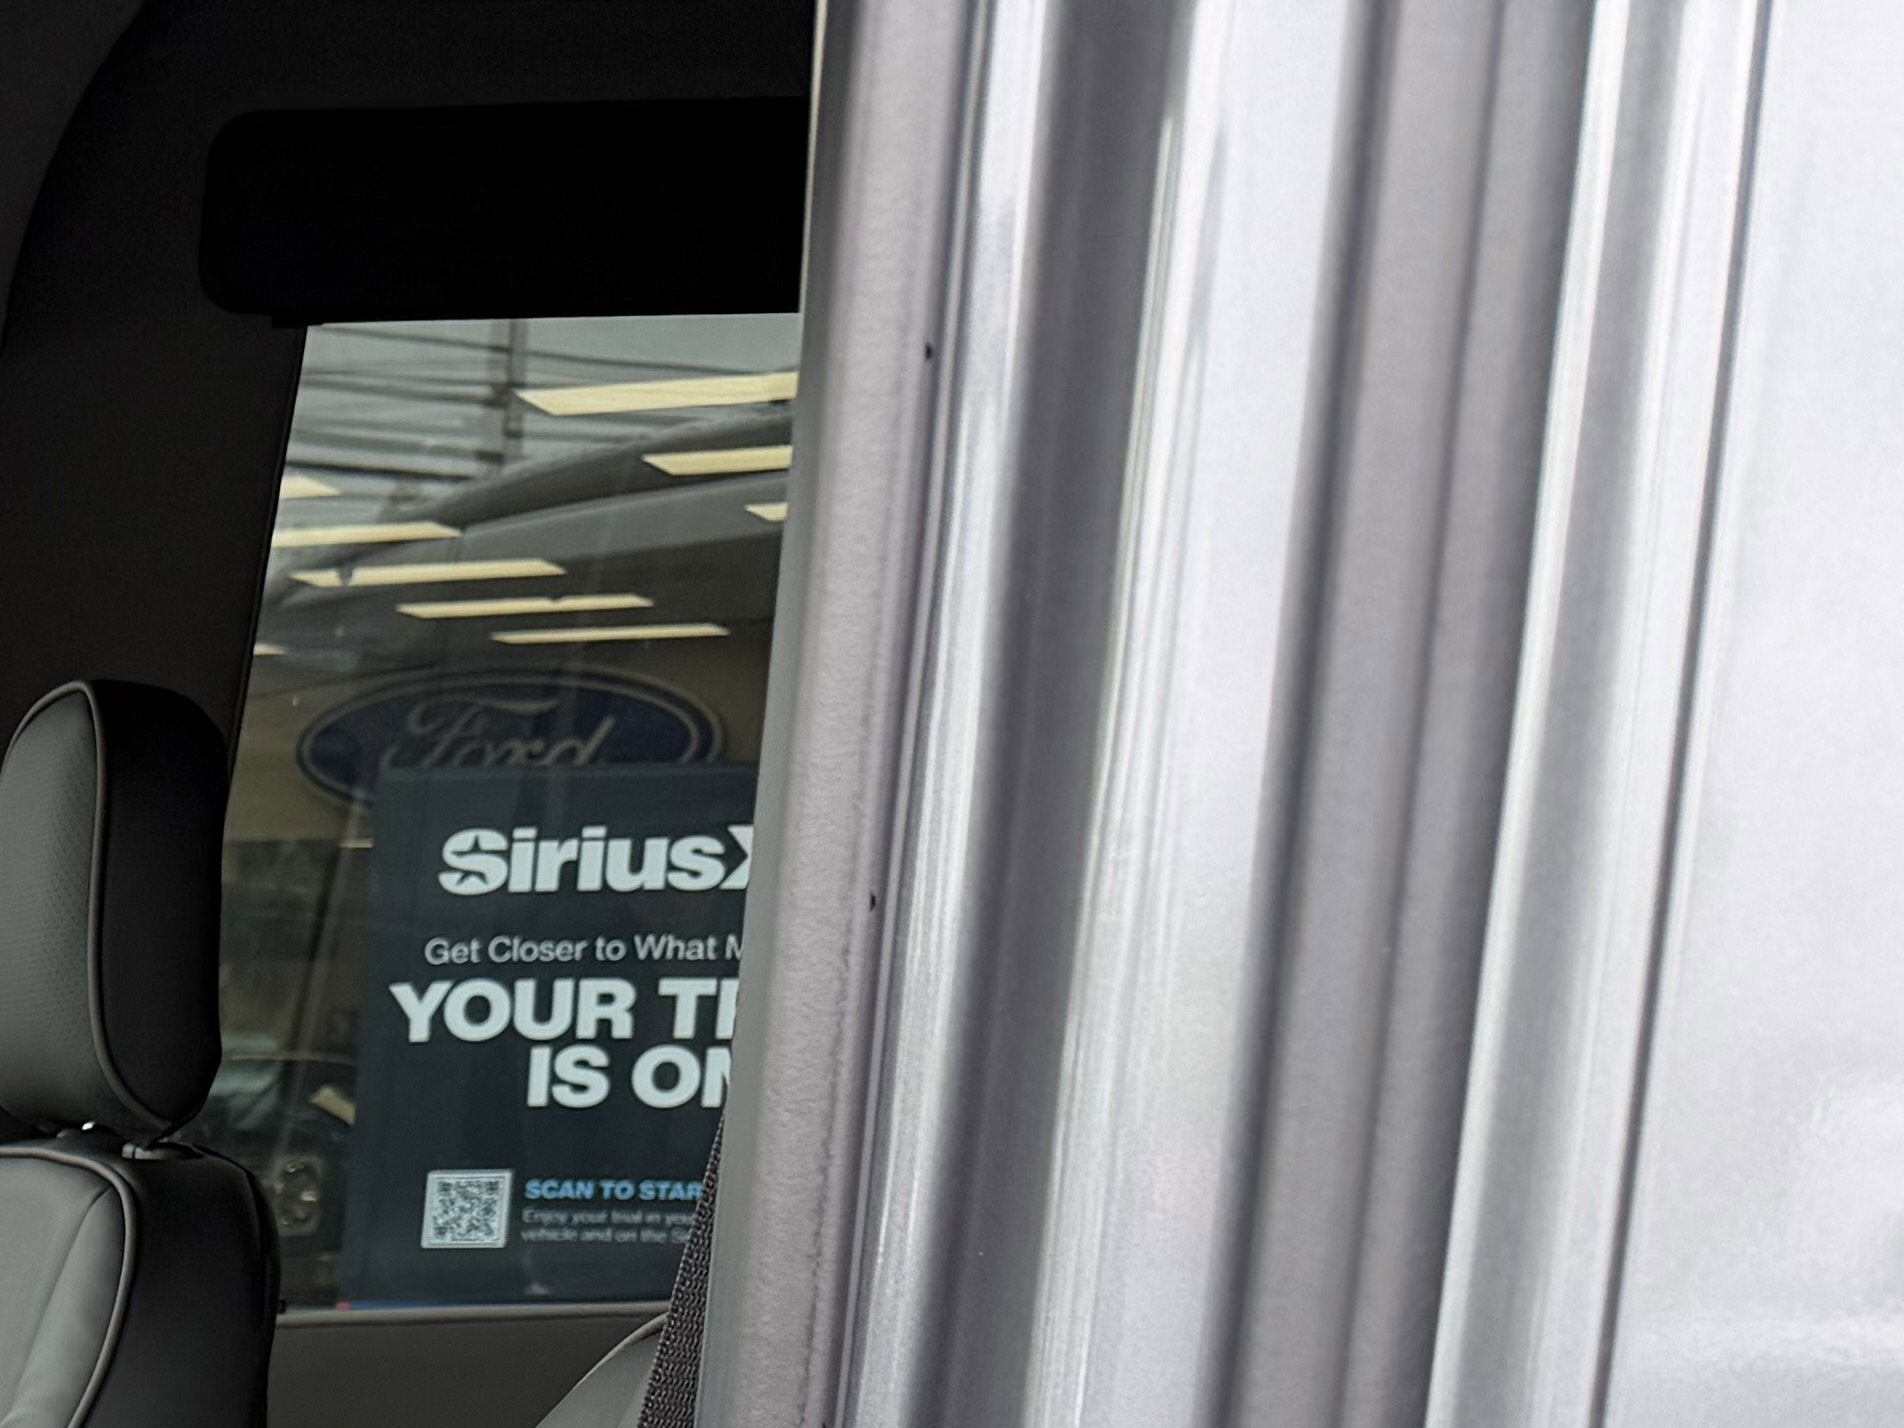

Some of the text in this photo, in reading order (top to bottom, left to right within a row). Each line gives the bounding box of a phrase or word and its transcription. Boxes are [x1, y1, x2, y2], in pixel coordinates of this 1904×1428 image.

[424, 937, 482, 964] Get
[488, 936, 588, 964] Closer
[596, 934, 626, 961] to
[634, 935, 717, 961] What
[389, 978, 637, 1043] YOUR
[526, 1046, 610, 1108] IS
[525, 1179, 595, 1200] SCAN
[599, 1180, 635, 1200] TO
[522, 1206, 693, 1227] Enjoy your trial in you
[521, 1228, 578, 1243] vehicle
[580, 1229, 612, 1243] and
[615, 1231, 636, 1245] on
[639, 1230, 667, 1244] the
